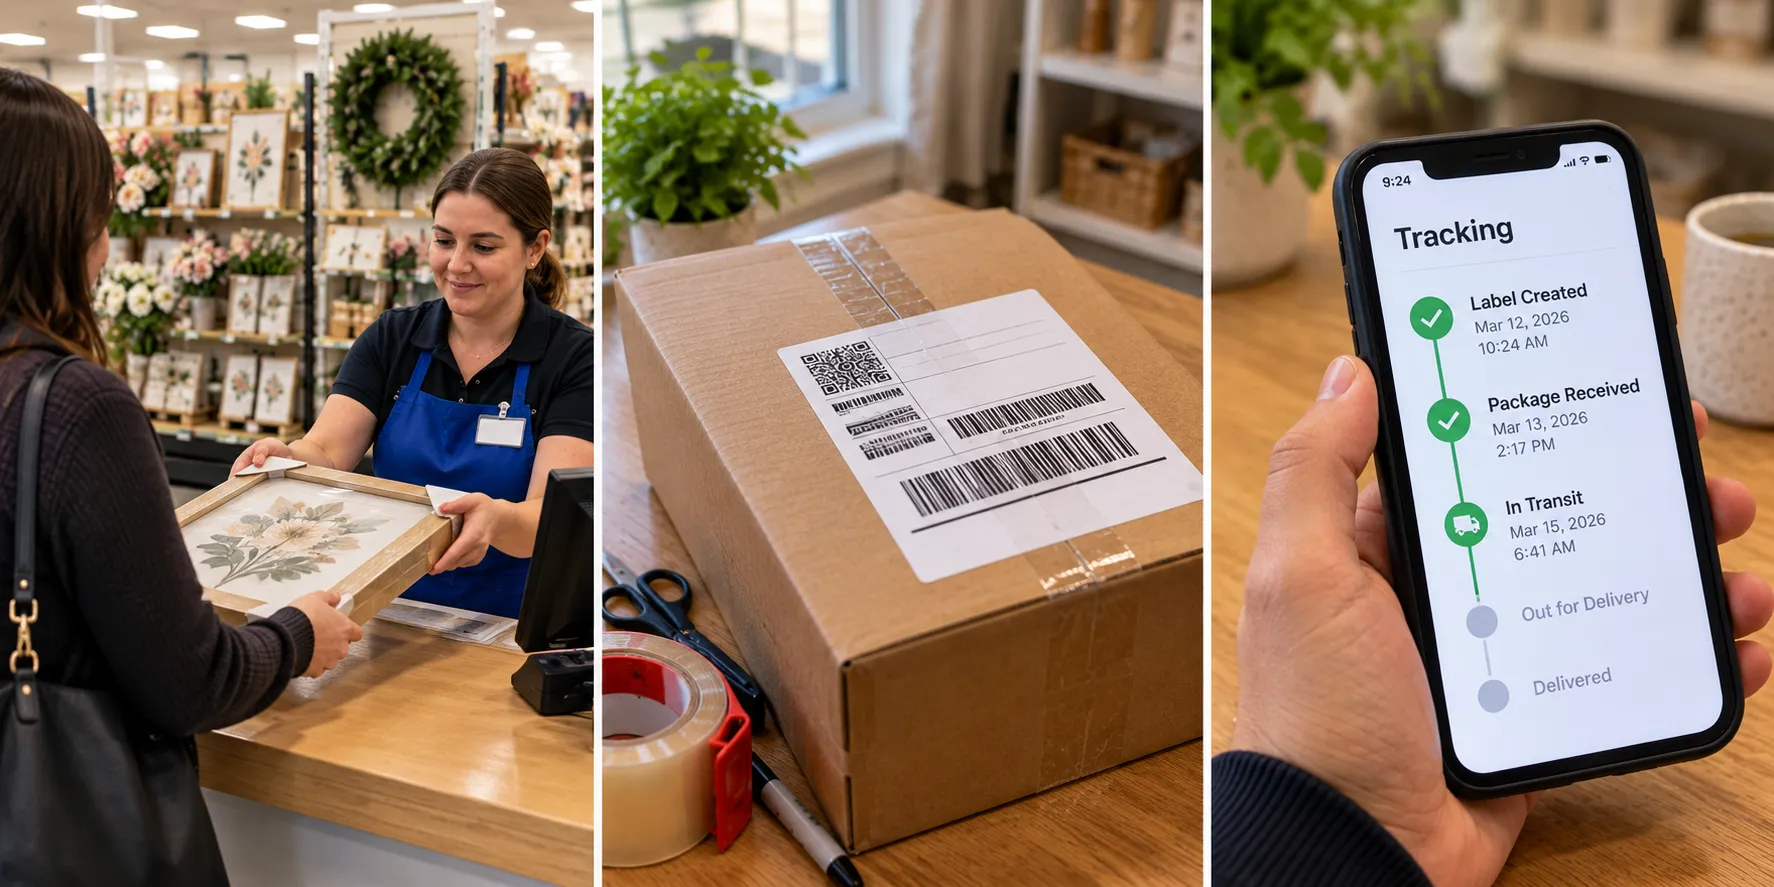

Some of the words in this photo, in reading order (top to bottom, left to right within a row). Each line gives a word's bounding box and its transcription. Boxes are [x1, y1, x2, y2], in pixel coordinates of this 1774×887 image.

[1382, 175, 1411, 188] 9:24
[1393, 219, 1513, 250] Tracking
[1470, 291, 1517, 311] Label
[1521, 282, 1588, 304] Created
[1475, 320, 1503, 334] Mar
[1507, 316, 1528, 330] 12,
[1532, 310, 1570, 327] 2026
[1478, 338, 1520, 355] 10:24
[1525, 334, 1548, 349] AM
[1488, 392, 1560, 412] Package
[1564, 378, 1640, 402] Received
[1492, 422, 1520, 436] Mar
[1525, 417, 1546, 432] 13,
[1550, 411, 1588, 428] 2026
[1496, 441, 1526, 458] 2:17
[1531, 437, 1555, 452] PM
[1506, 501, 1522, 515] In
[1525, 490, 1584, 511] Transit
[1510, 525, 1538, 539] Mar
[1543, 519, 1564, 534] 15,
[1568, 513, 1606, 530] 2026
[1514, 544, 1546, 561] 6:41
[1552, 539, 1576, 555] AM
[1522, 604, 1553, 621] Out
[1556, 601, 1579, 616] for
[1583, 590, 1649, 611] Delivery
[1533, 667, 1612, 695] Delivered
